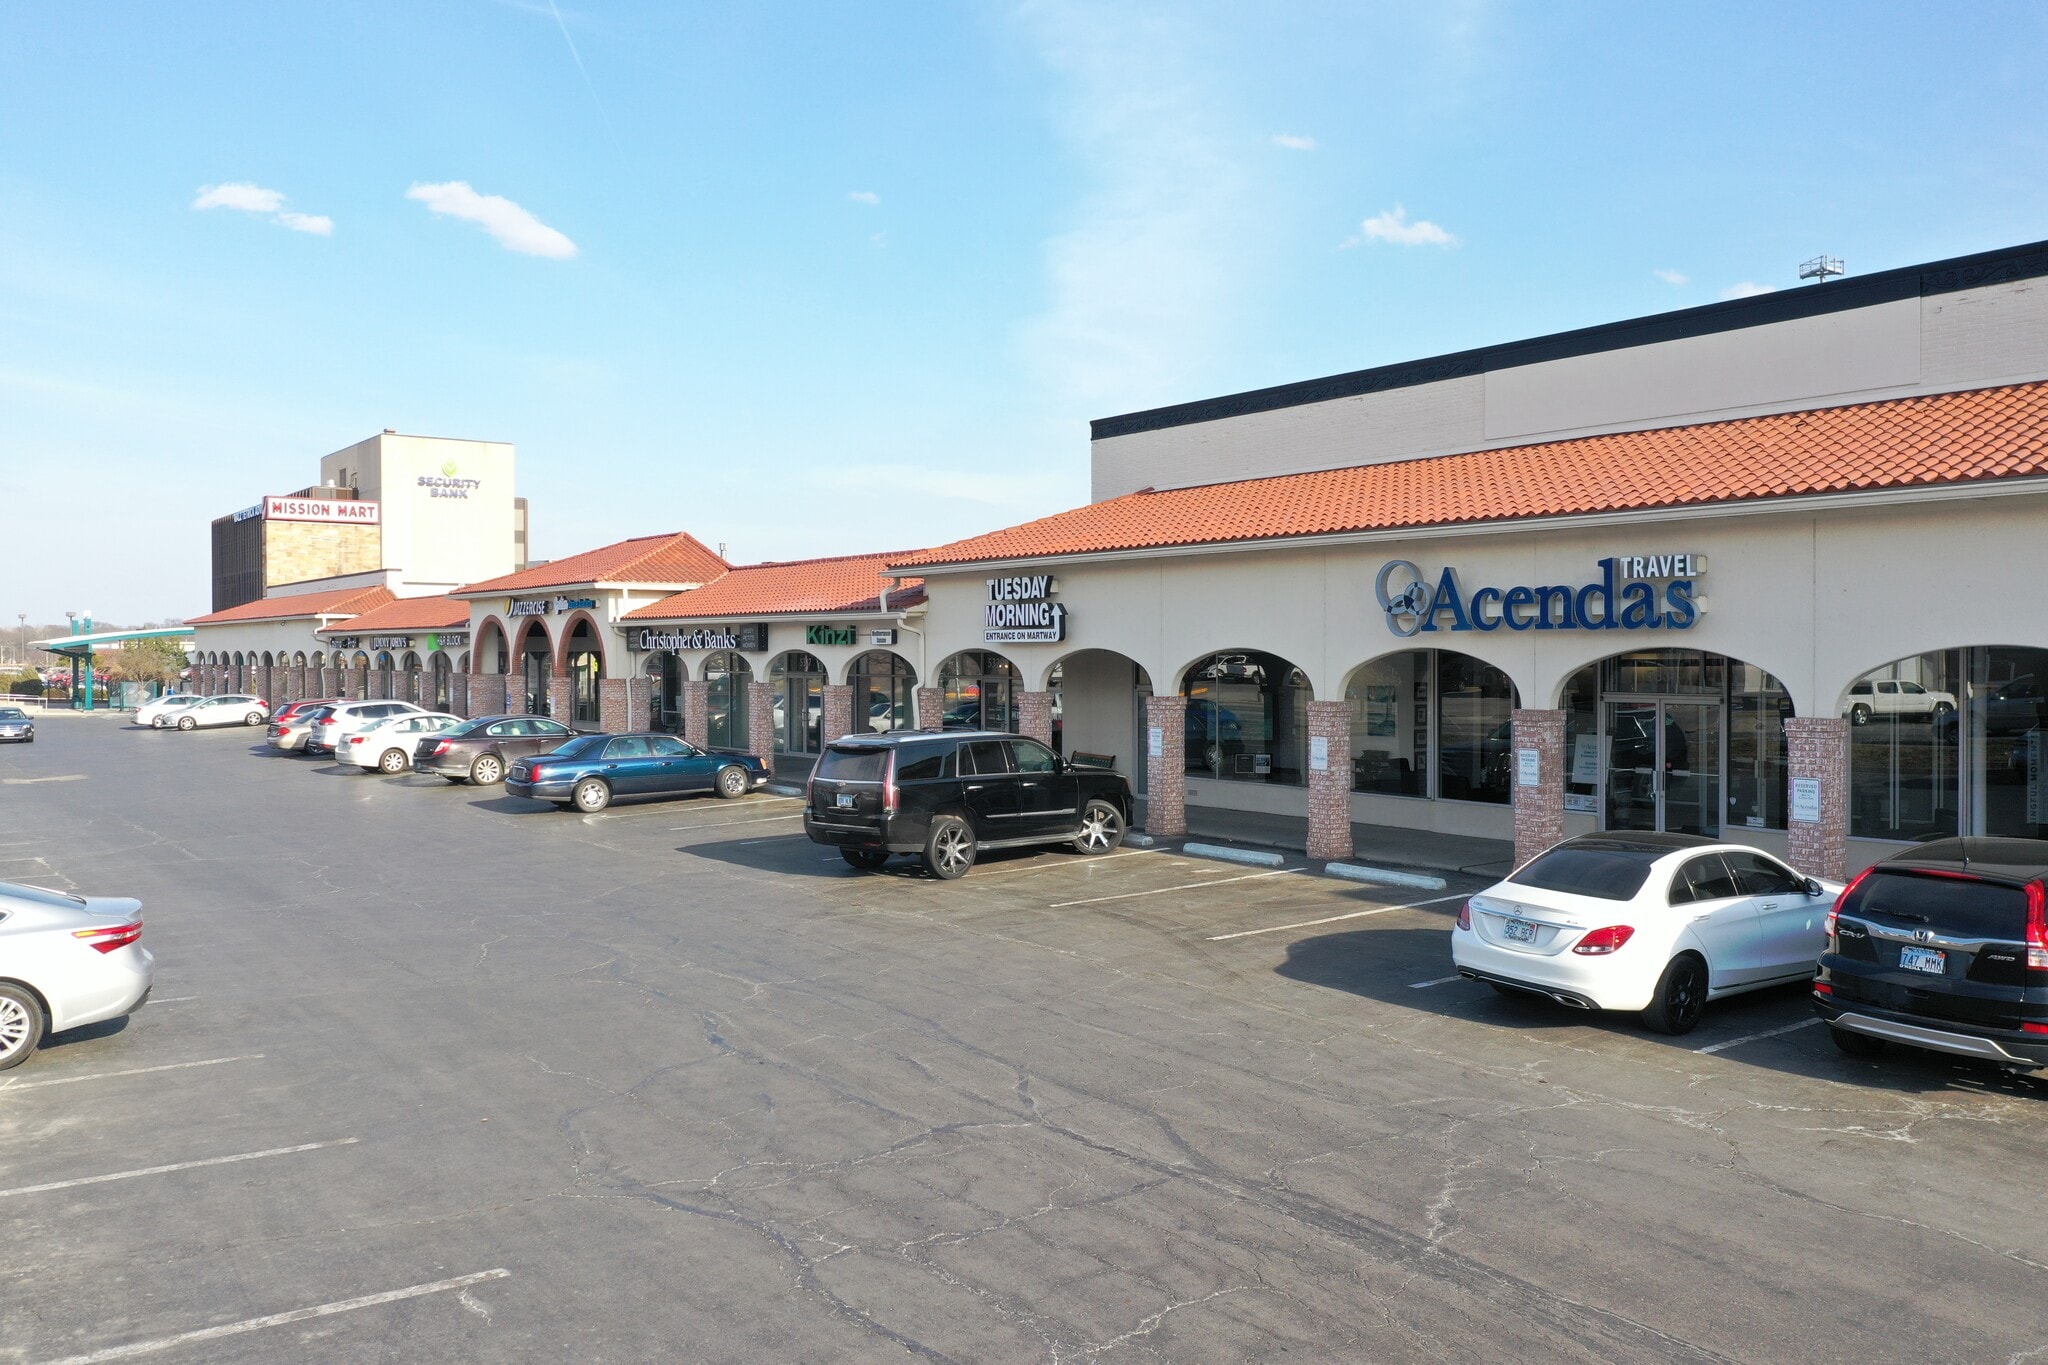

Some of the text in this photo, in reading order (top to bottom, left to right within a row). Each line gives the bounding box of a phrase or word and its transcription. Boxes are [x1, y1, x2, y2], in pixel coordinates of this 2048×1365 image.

[417, 476, 481, 489] SECURITY
[430, 488, 468, 499] BANK
[272, 502, 330, 516] MISSION
[338, 505, 375, 518] MART
[1620, 554, 1697, 578] TRAVEL
[986, 575, 1048, 600] TUESDAY
[1420, 557, 1702, 632] Acendas
[513, 600, 545, 615] JAZZERCISE
[985, 602, 1049, 627] MORNING
[640, 628, 691, 655] Christopher
[692, 629, 704, 648] &
[704, 627, 736, 648] Banks
[806, 625, 853, 644] Kinzi
[986, 632, 1015, 640] ENTRANCE
[1027, 631, 1056, 639] MARTWAY
[1902, 953, 1942, 970] 747 MMK
[1987, 954, 2016, 962] AWD
